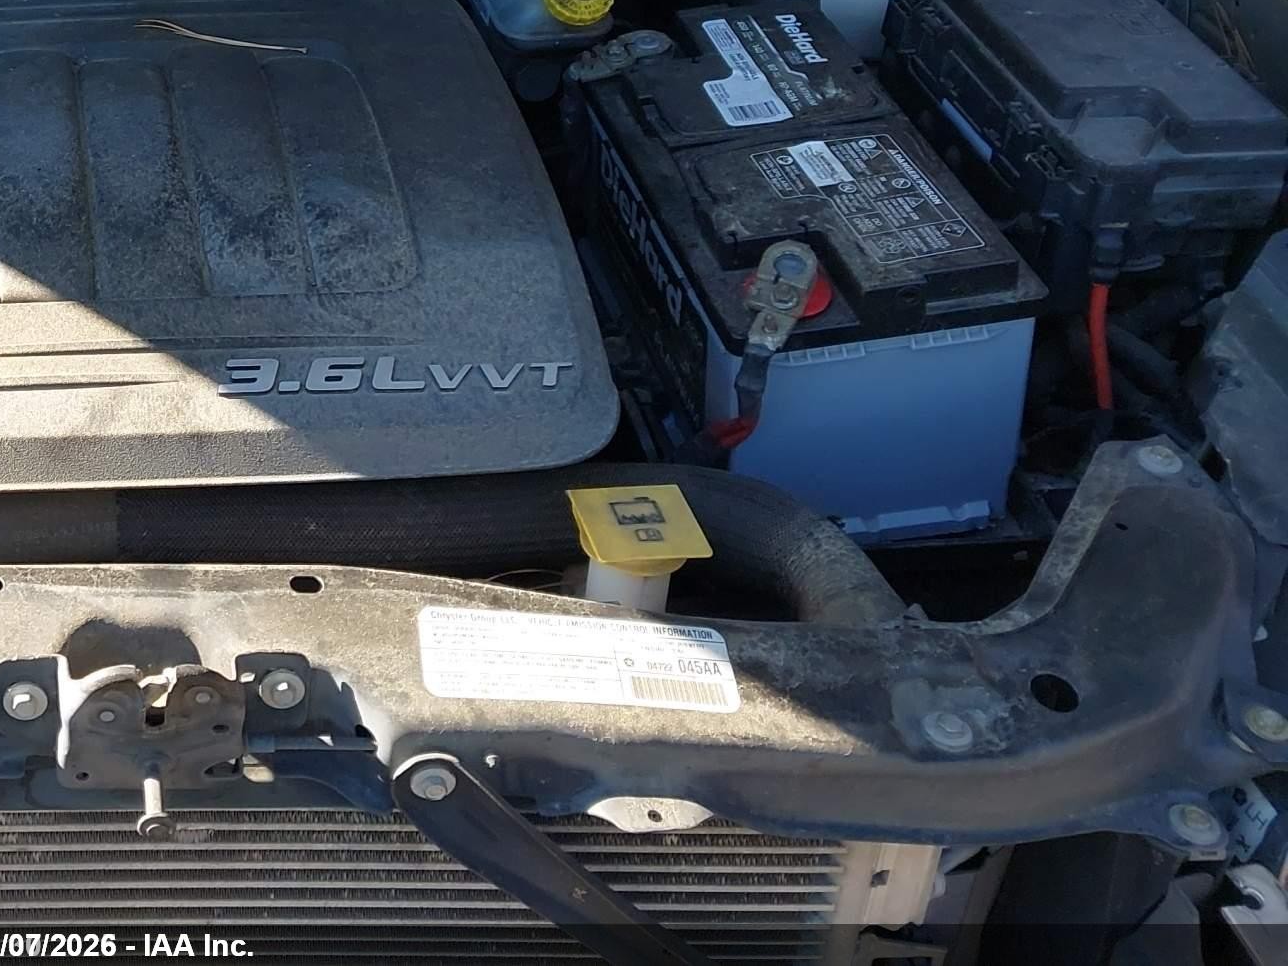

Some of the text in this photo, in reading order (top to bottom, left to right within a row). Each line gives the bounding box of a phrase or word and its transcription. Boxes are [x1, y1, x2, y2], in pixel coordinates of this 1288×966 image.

[775, 13, 829, 64] DieHard
[652, 626, 714, 640] INFORMATION
[677, 659, 723, 677] 045AA
